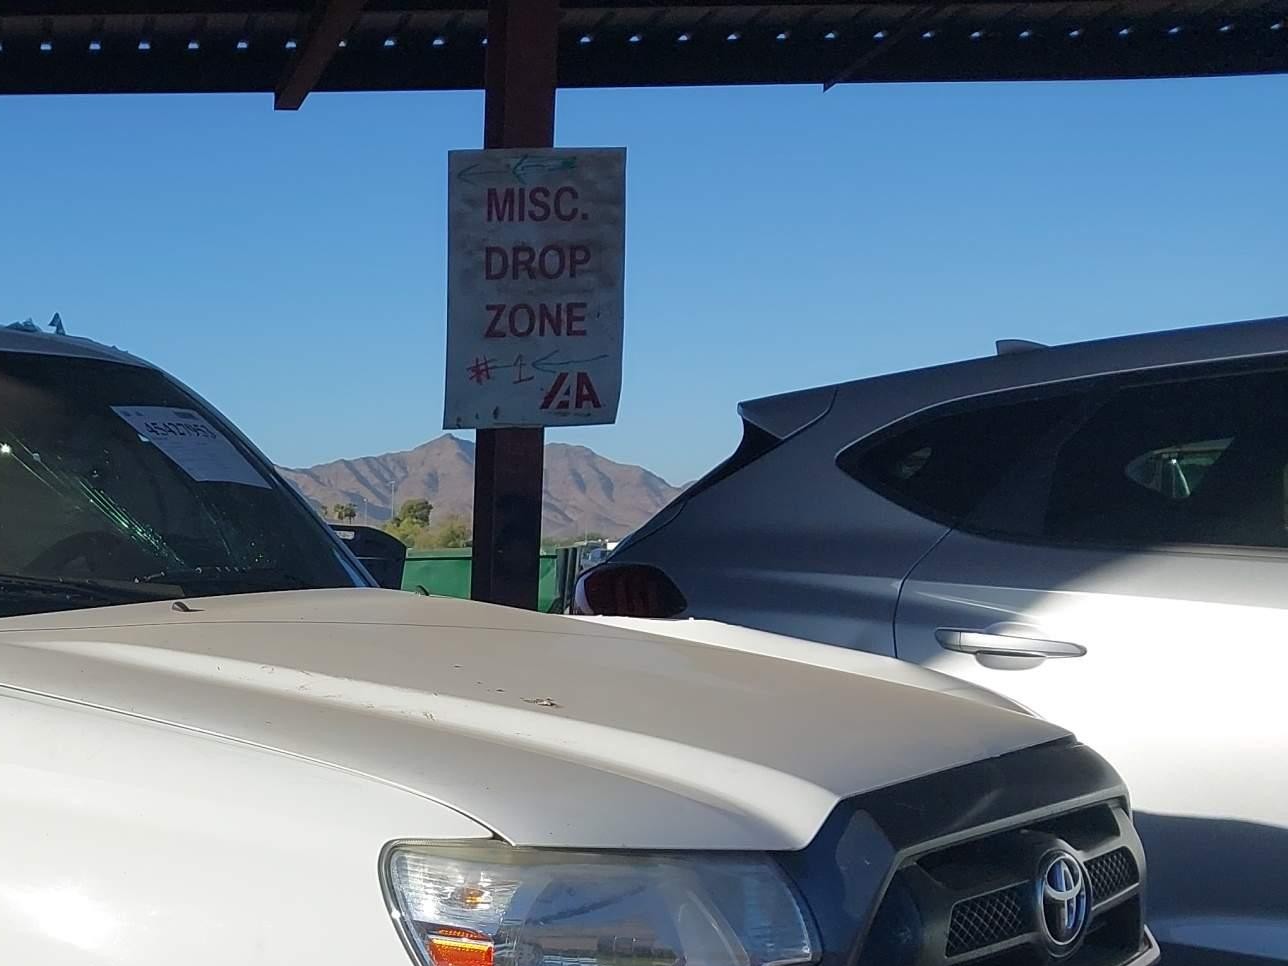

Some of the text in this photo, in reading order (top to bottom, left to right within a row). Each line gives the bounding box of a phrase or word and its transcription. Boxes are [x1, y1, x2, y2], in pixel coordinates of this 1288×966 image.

[486, 186, 589, 223] MISC.
[484, 245, 592, 281] DROP
[484, 302, 588, 338] ZONE
